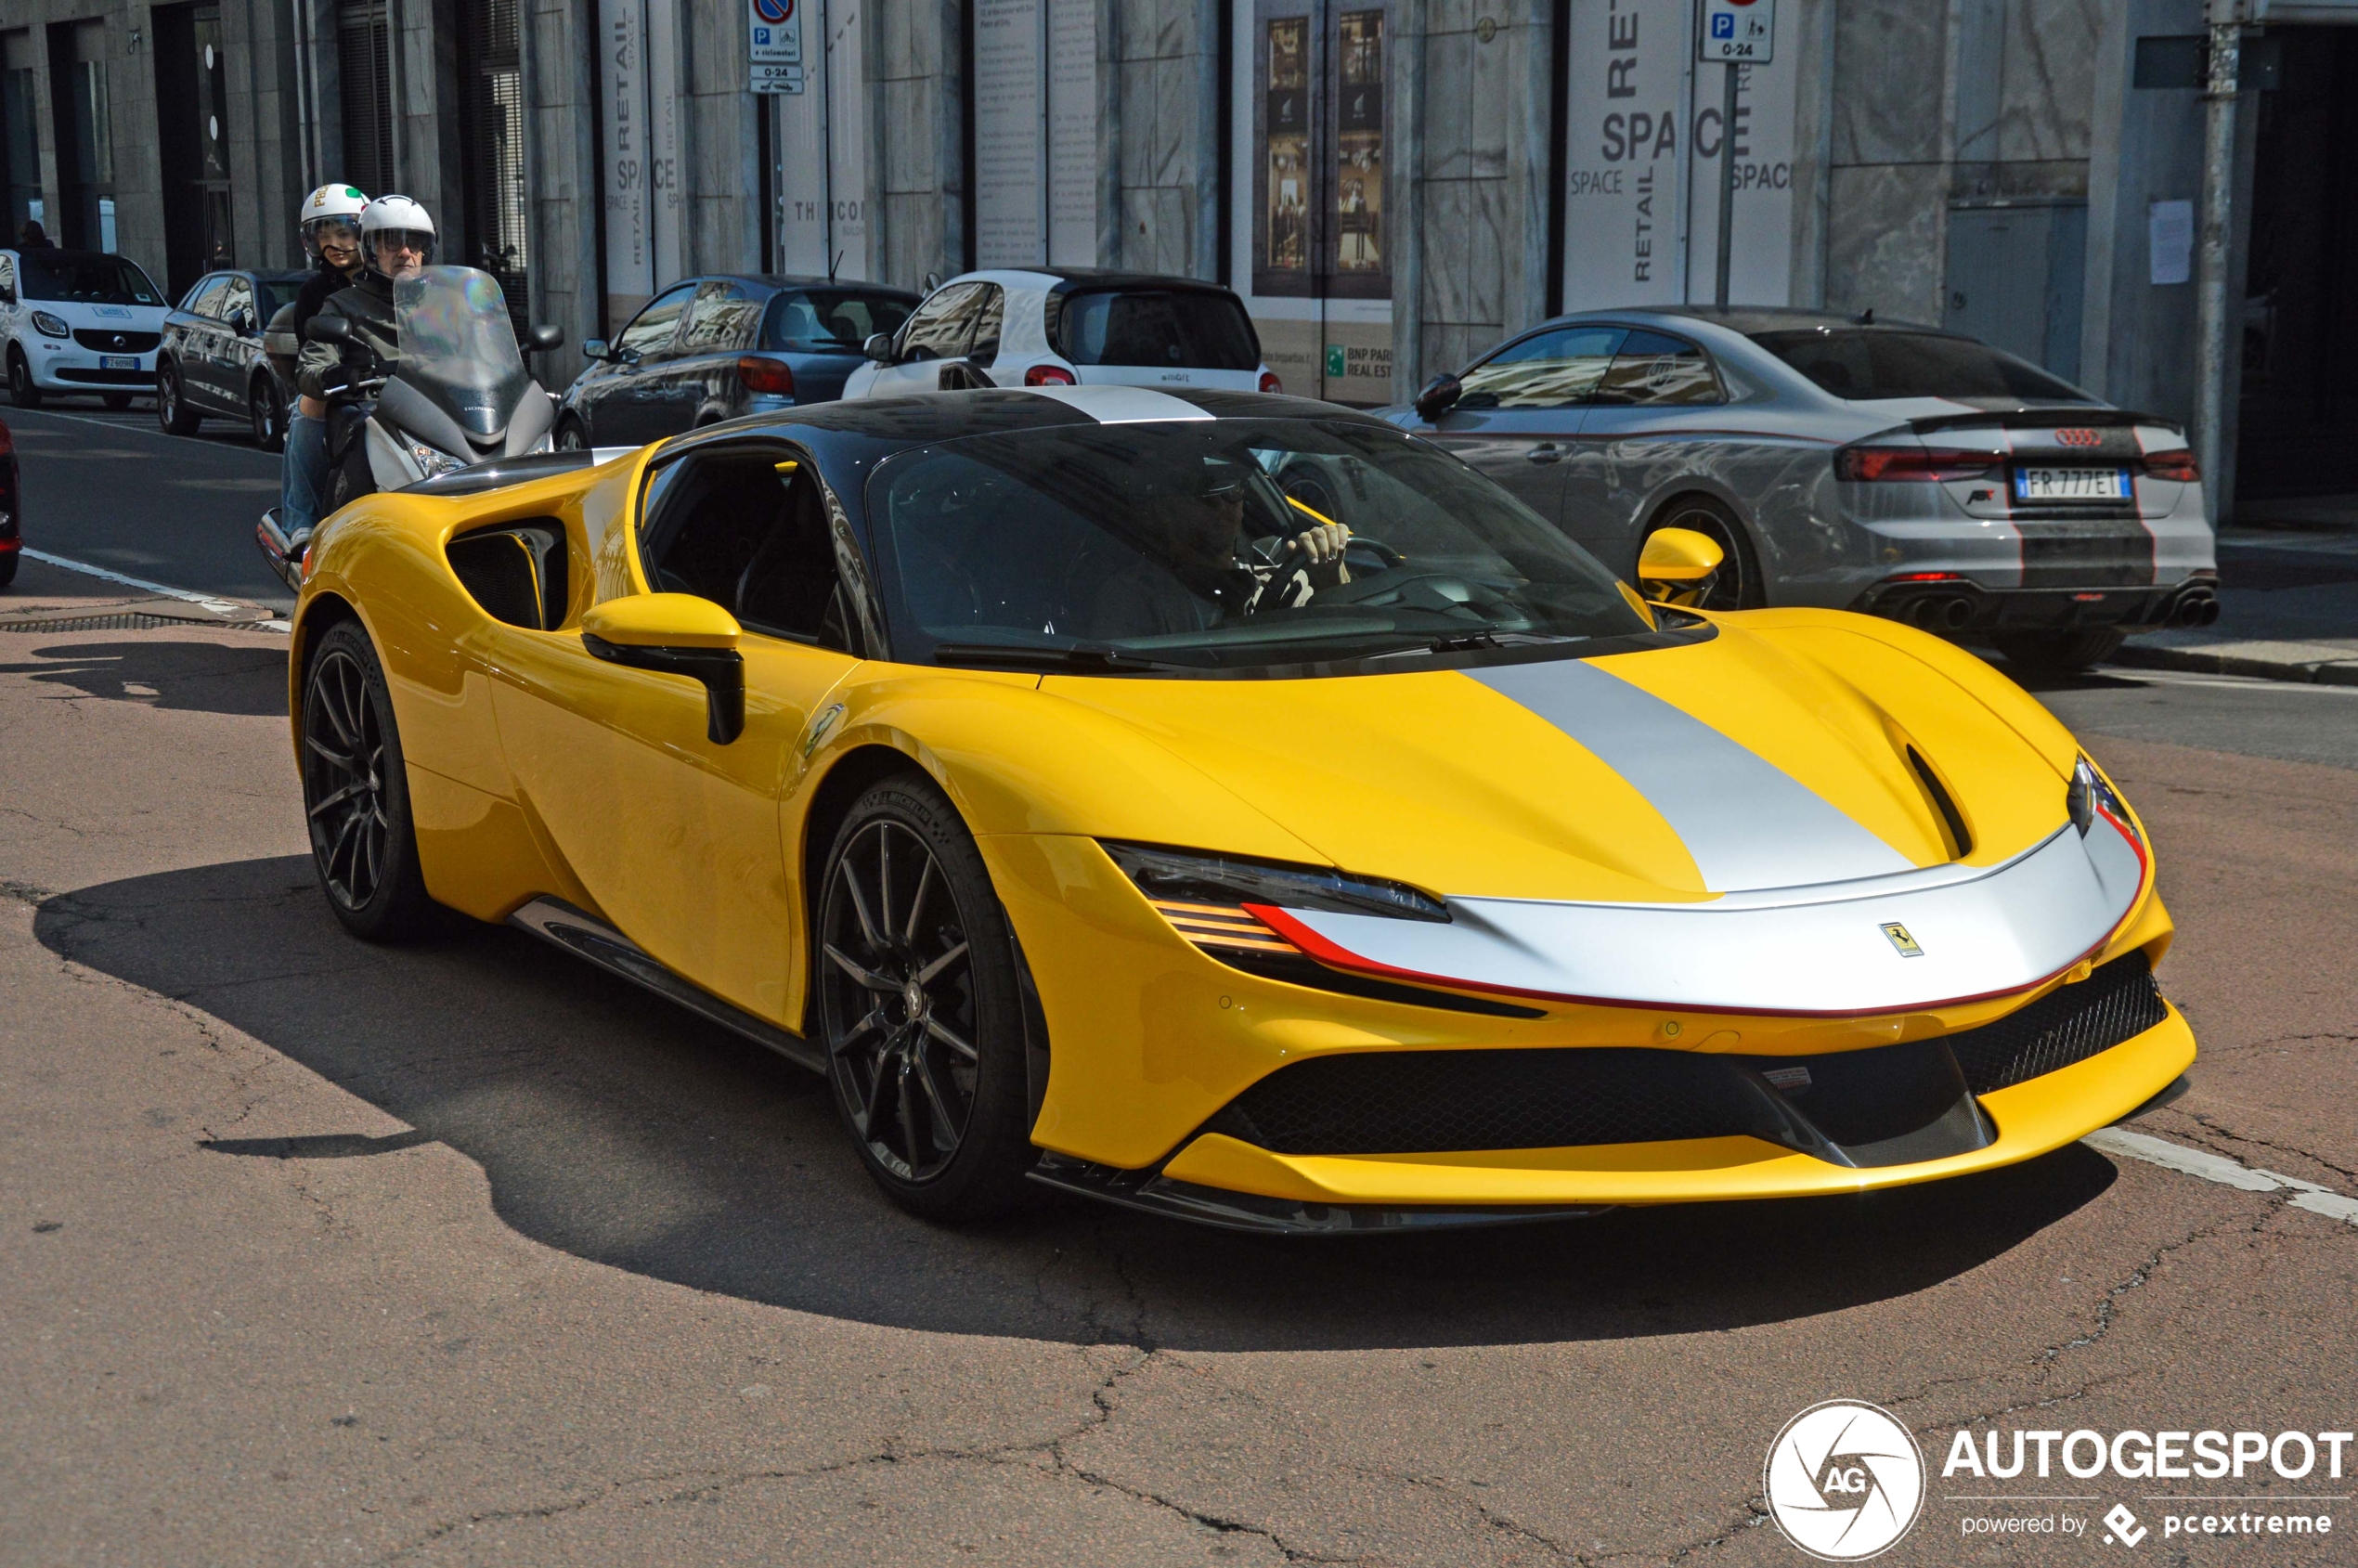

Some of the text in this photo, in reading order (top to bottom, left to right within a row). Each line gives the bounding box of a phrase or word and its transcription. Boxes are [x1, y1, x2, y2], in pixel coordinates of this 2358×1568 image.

[757, 31, 767, 43] P
[1716, 17, 1730, 35] P
[1722, 43, 1753, 56] 0-24
[615, 7, 629, 151] RETAIL
[1571, 169, 1624, 196] SPACE
[1732, 162, 1793, 190] SPAC
[795, 201, 820, 221] TH
[633, 195, 641, 266] RETAIL
[1635, 165, 1653, 282] RETAIL
[1347, 347, 1369, 361] BNP
[1347, 364, 1372, 376] REAL
[888, 792, 931, 823] MICHELIN
